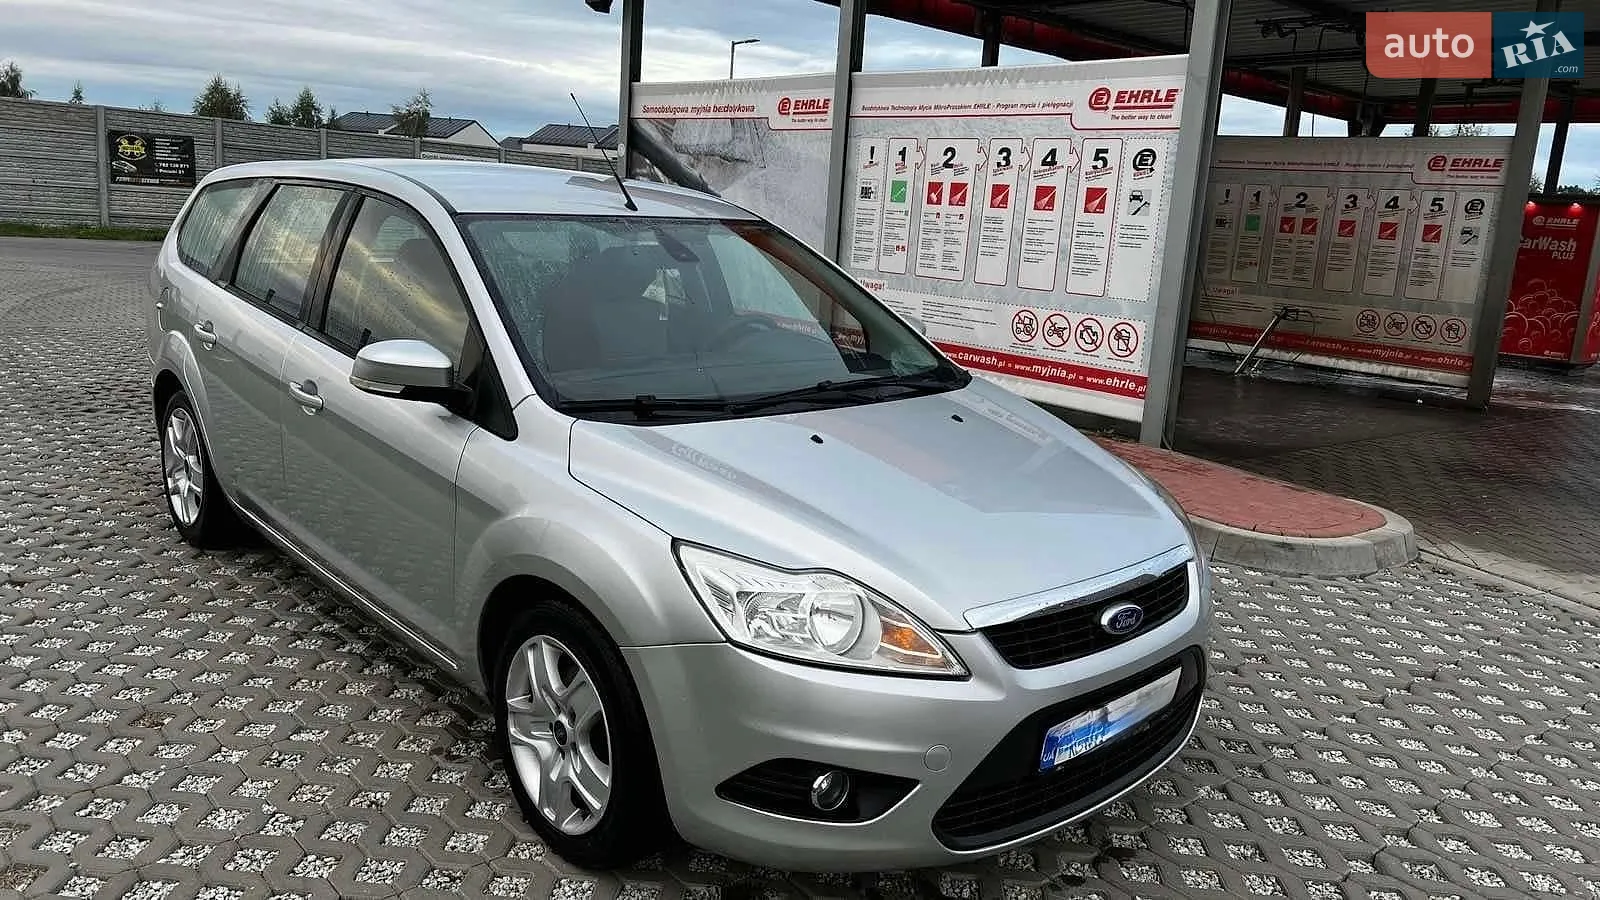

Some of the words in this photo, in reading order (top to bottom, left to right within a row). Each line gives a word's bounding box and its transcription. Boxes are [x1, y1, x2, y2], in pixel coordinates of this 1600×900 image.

[793, 98, 831, 110] EHRLE
[1114, 88, 1180, 104] EHRLE
[691, 103, 712, 115] myjnia
[898, 146, 907, 166] 1
[942, 146, 957, 169] 2
[996, 146, 1012, 169] 3
[1040, 147, 1058, 168] 4
[1091, 148, 1109, 170] 5
[1450, 158, 1505, 168] EHRLE
[1252, 190, 1261, 204] 1
[1295, 191, 1309, 209] 2
[1346, 193, 1358, 210] 3
[1384, 195, 1400, 211] 4
[1429, 197, 1445, 213] 5
[1551, 251, 1576, 261] PLUS
[1014, 363, 1077, 381] www.myjnia.pl
[1086, 375, 1147, 393] www.ehrle.pl
[1115, 610, 1137, 629] Ford
